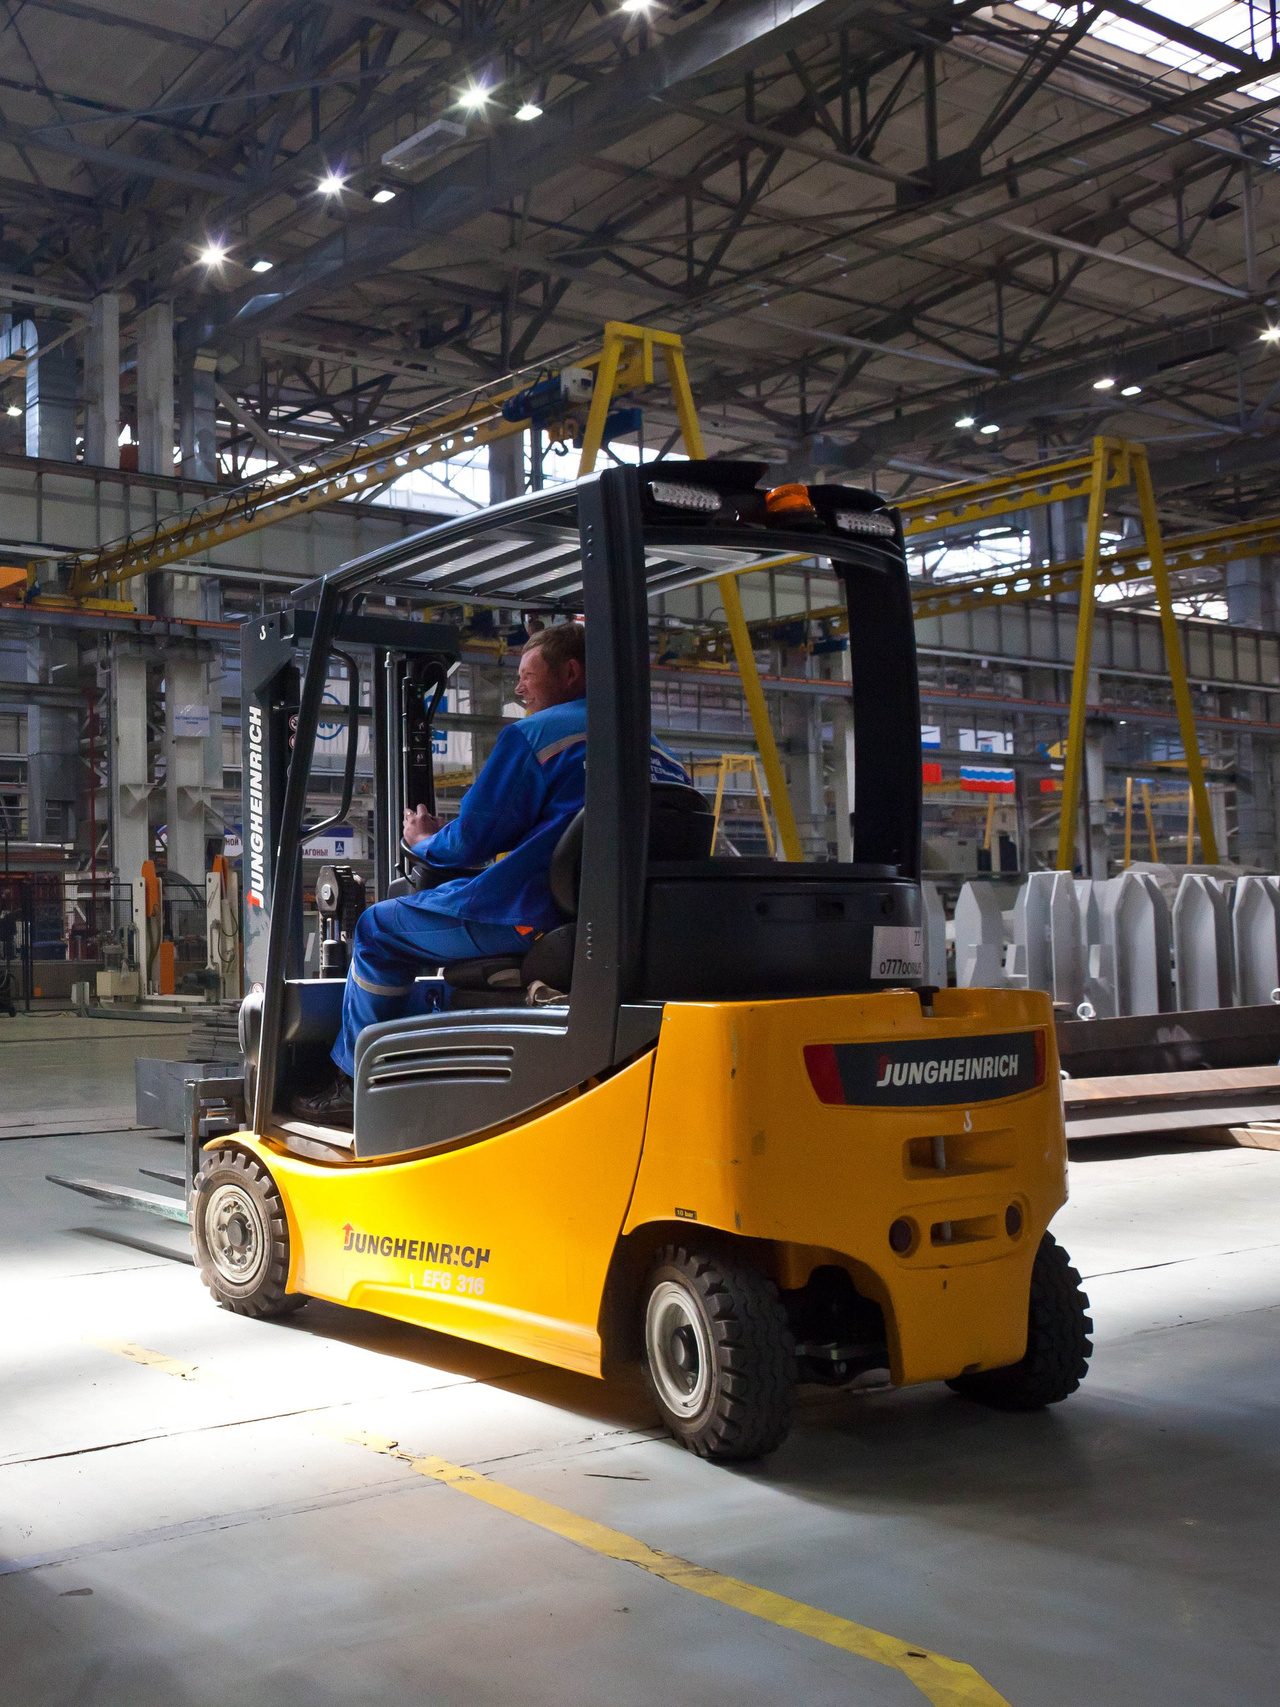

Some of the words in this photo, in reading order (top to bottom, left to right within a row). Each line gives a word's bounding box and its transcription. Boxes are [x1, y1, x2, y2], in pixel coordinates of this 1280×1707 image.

[248, 705, 265, 909] JUNGHEINRICH
[876, 1053, 1019, 1088] JUNGHEINRICH
[422, 1269, 452, 1291] EFG
[456, 1275, 485, 1296] 316
